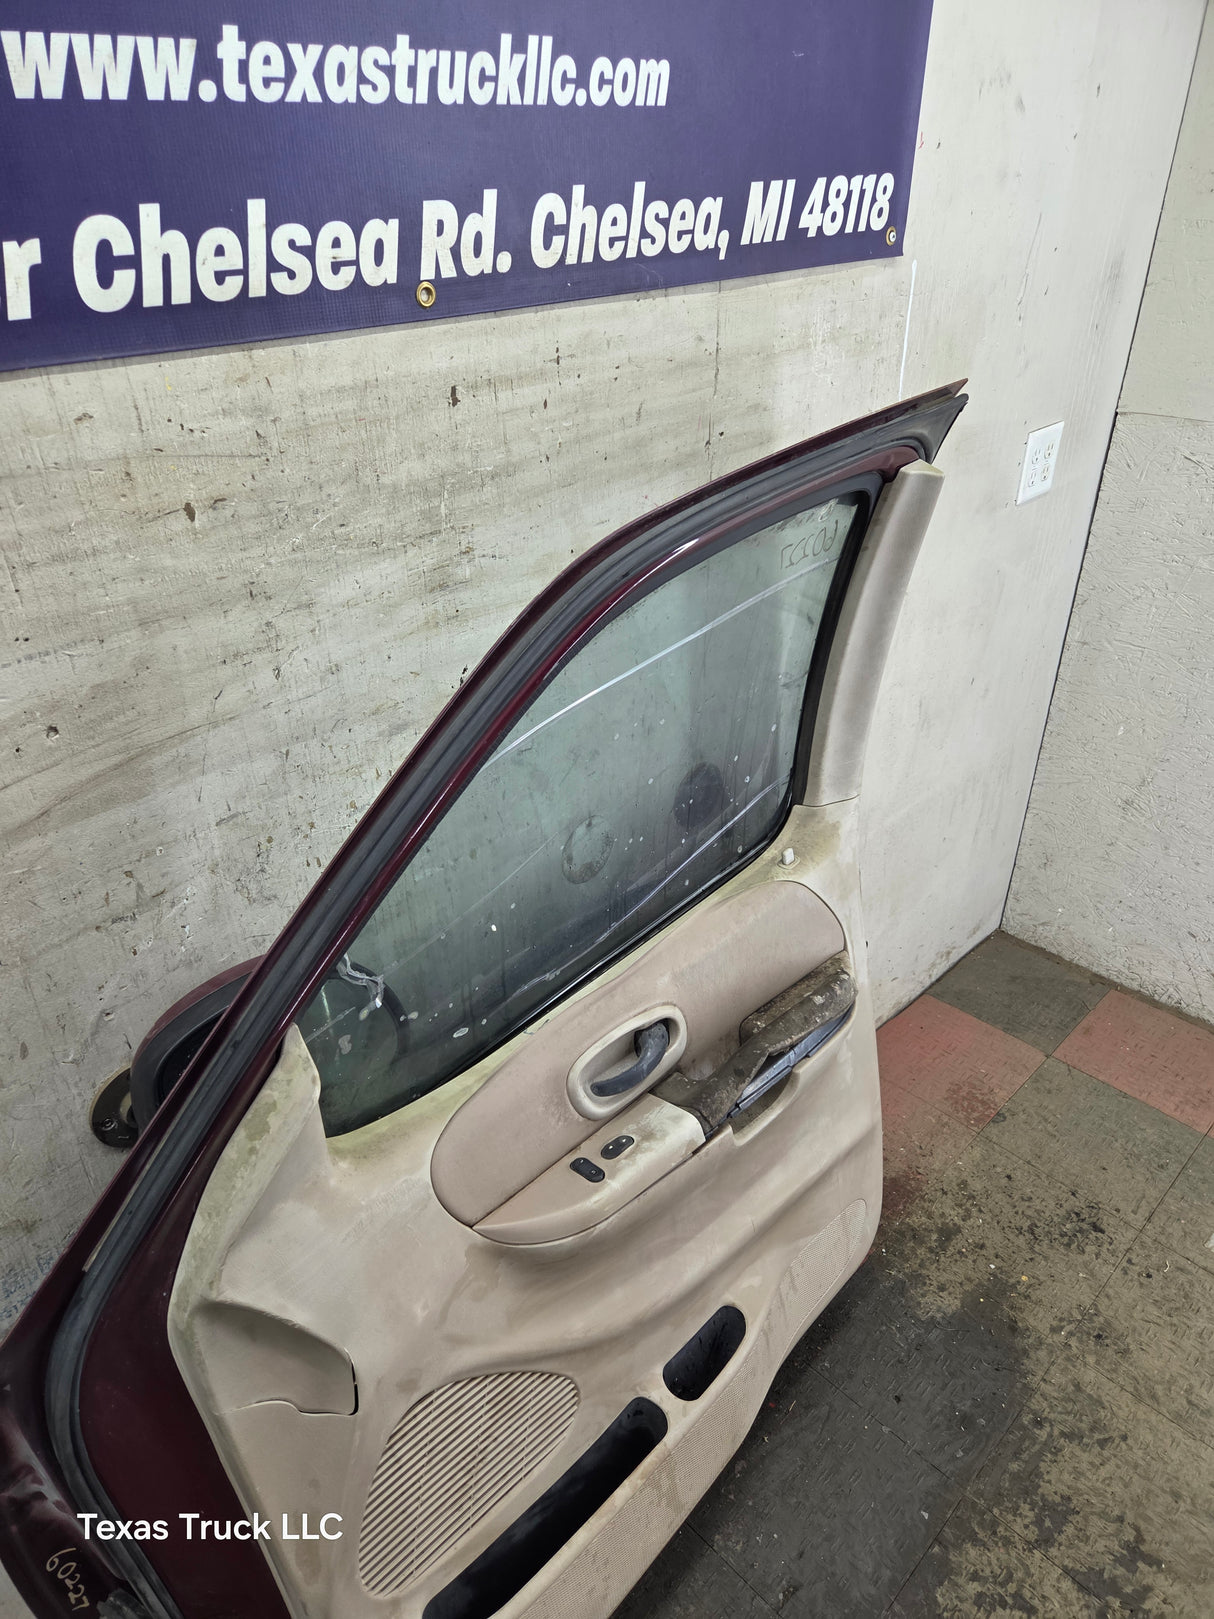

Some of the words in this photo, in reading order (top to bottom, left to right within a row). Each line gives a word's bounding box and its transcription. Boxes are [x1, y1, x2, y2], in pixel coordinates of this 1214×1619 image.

[0, 24, 671, 107] www.texastruckllc.com
[73, 198, 399, 312] Chelsea
[420, 188, 512, 280] Rd.
[530, 181, 730, 269] Chelsea,
[740, 179, 796, 246] MI
[799, 172, 895, 237] 48118
[46, 1547, 90, 1611] 60227
